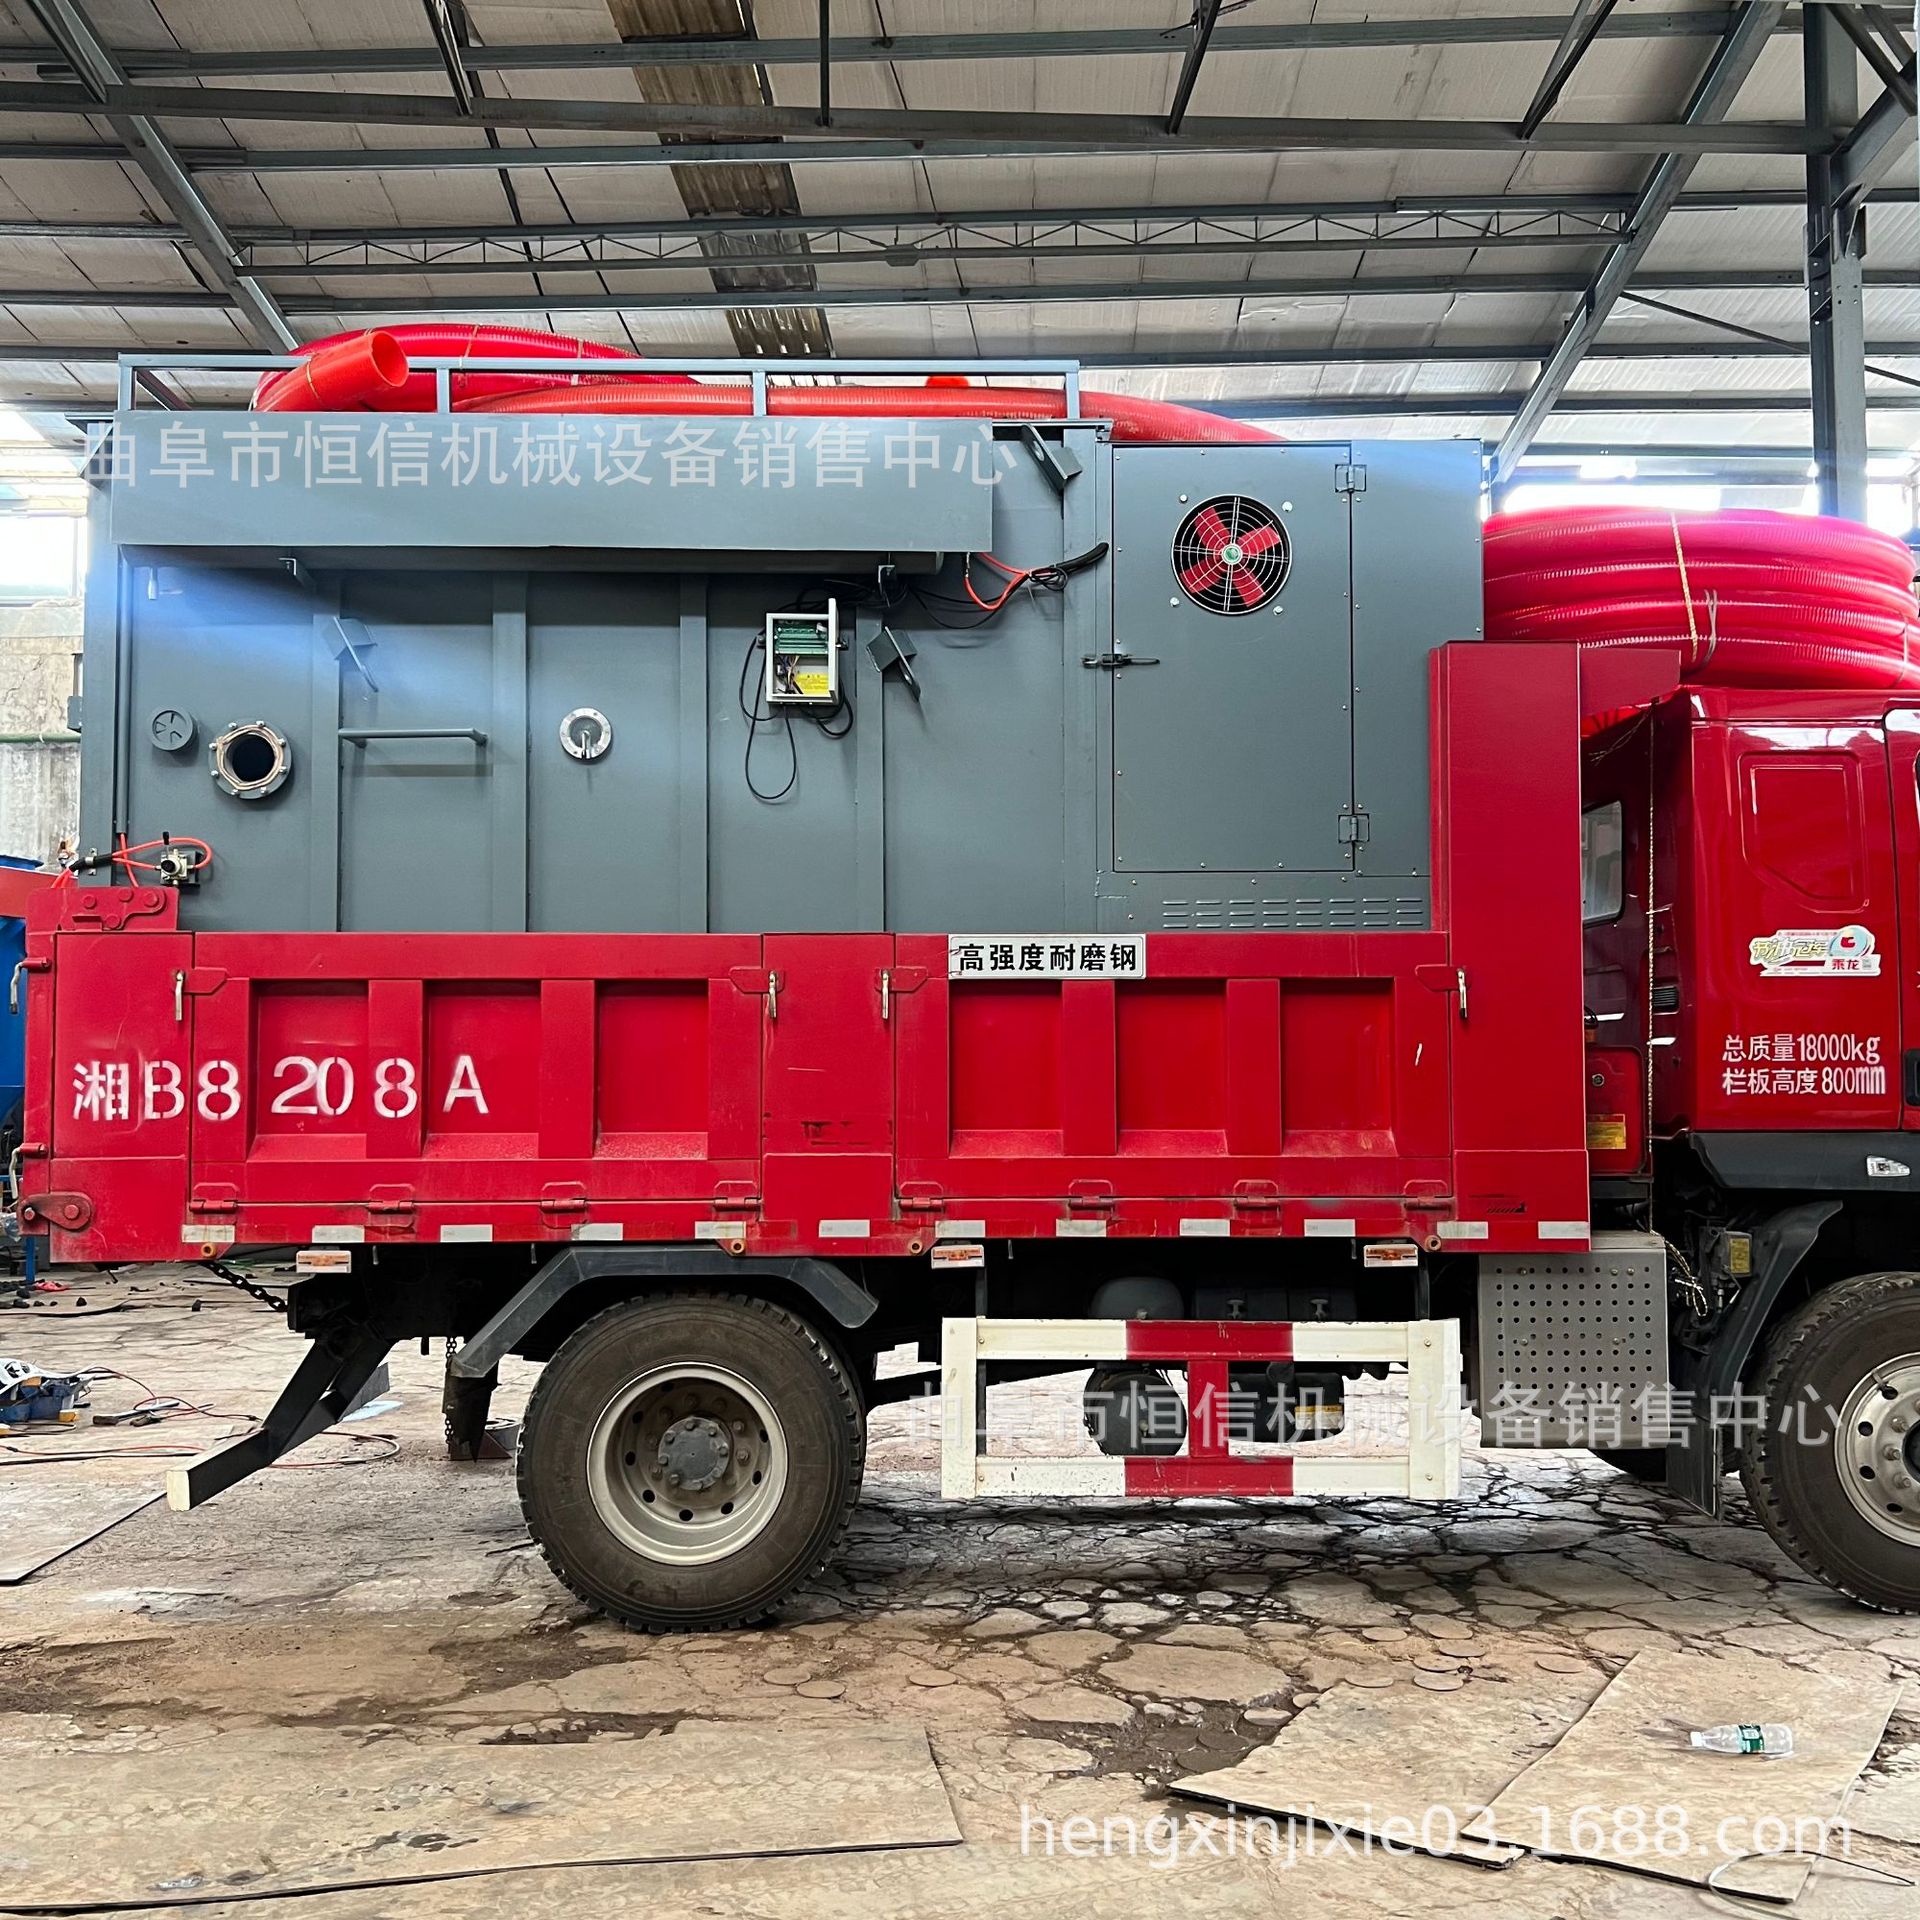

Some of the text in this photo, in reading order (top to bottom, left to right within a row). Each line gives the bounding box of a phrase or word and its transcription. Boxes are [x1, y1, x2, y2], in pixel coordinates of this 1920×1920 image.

[958, 943, 1136, 971] 高强度耐磨钢
[1721, 1033, 1881, 1065] 总质量18000kg
